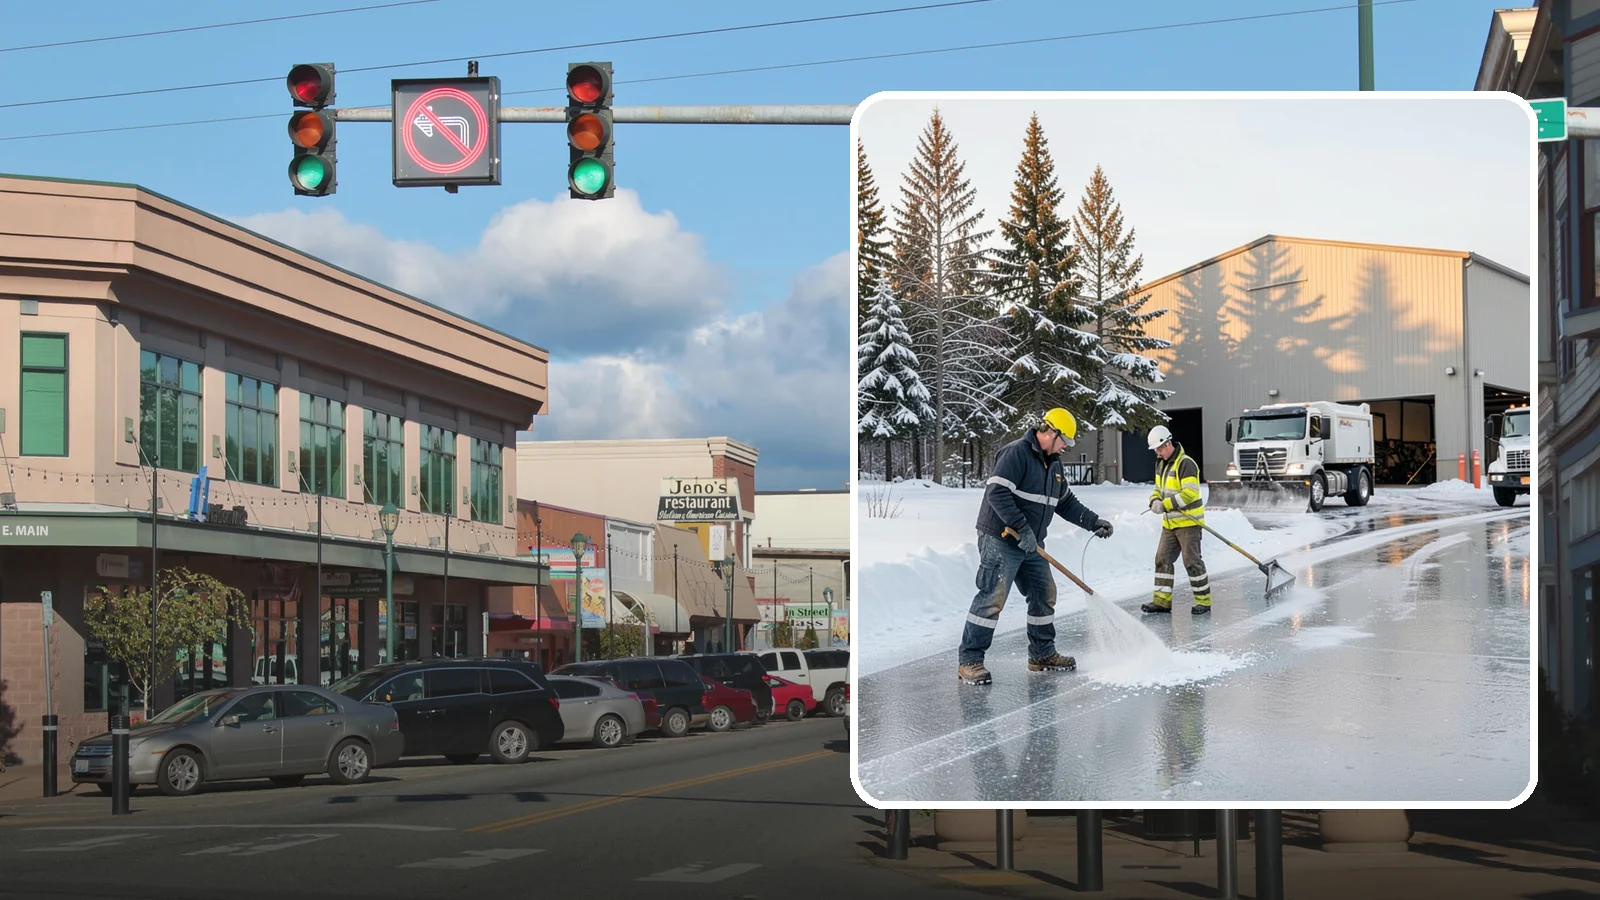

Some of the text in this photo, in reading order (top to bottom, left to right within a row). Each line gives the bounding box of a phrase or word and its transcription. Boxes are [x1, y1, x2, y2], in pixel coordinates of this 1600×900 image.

[669, 480, 728, 494] Jeno's
[665, 496, 731, 509] restaurant
[686, 510, 714, 519] American
[715, 510, 737, 519] Cuisine
[2, 525, 49, 536] E. MAIN
[797, 607, 828, 617] Street
